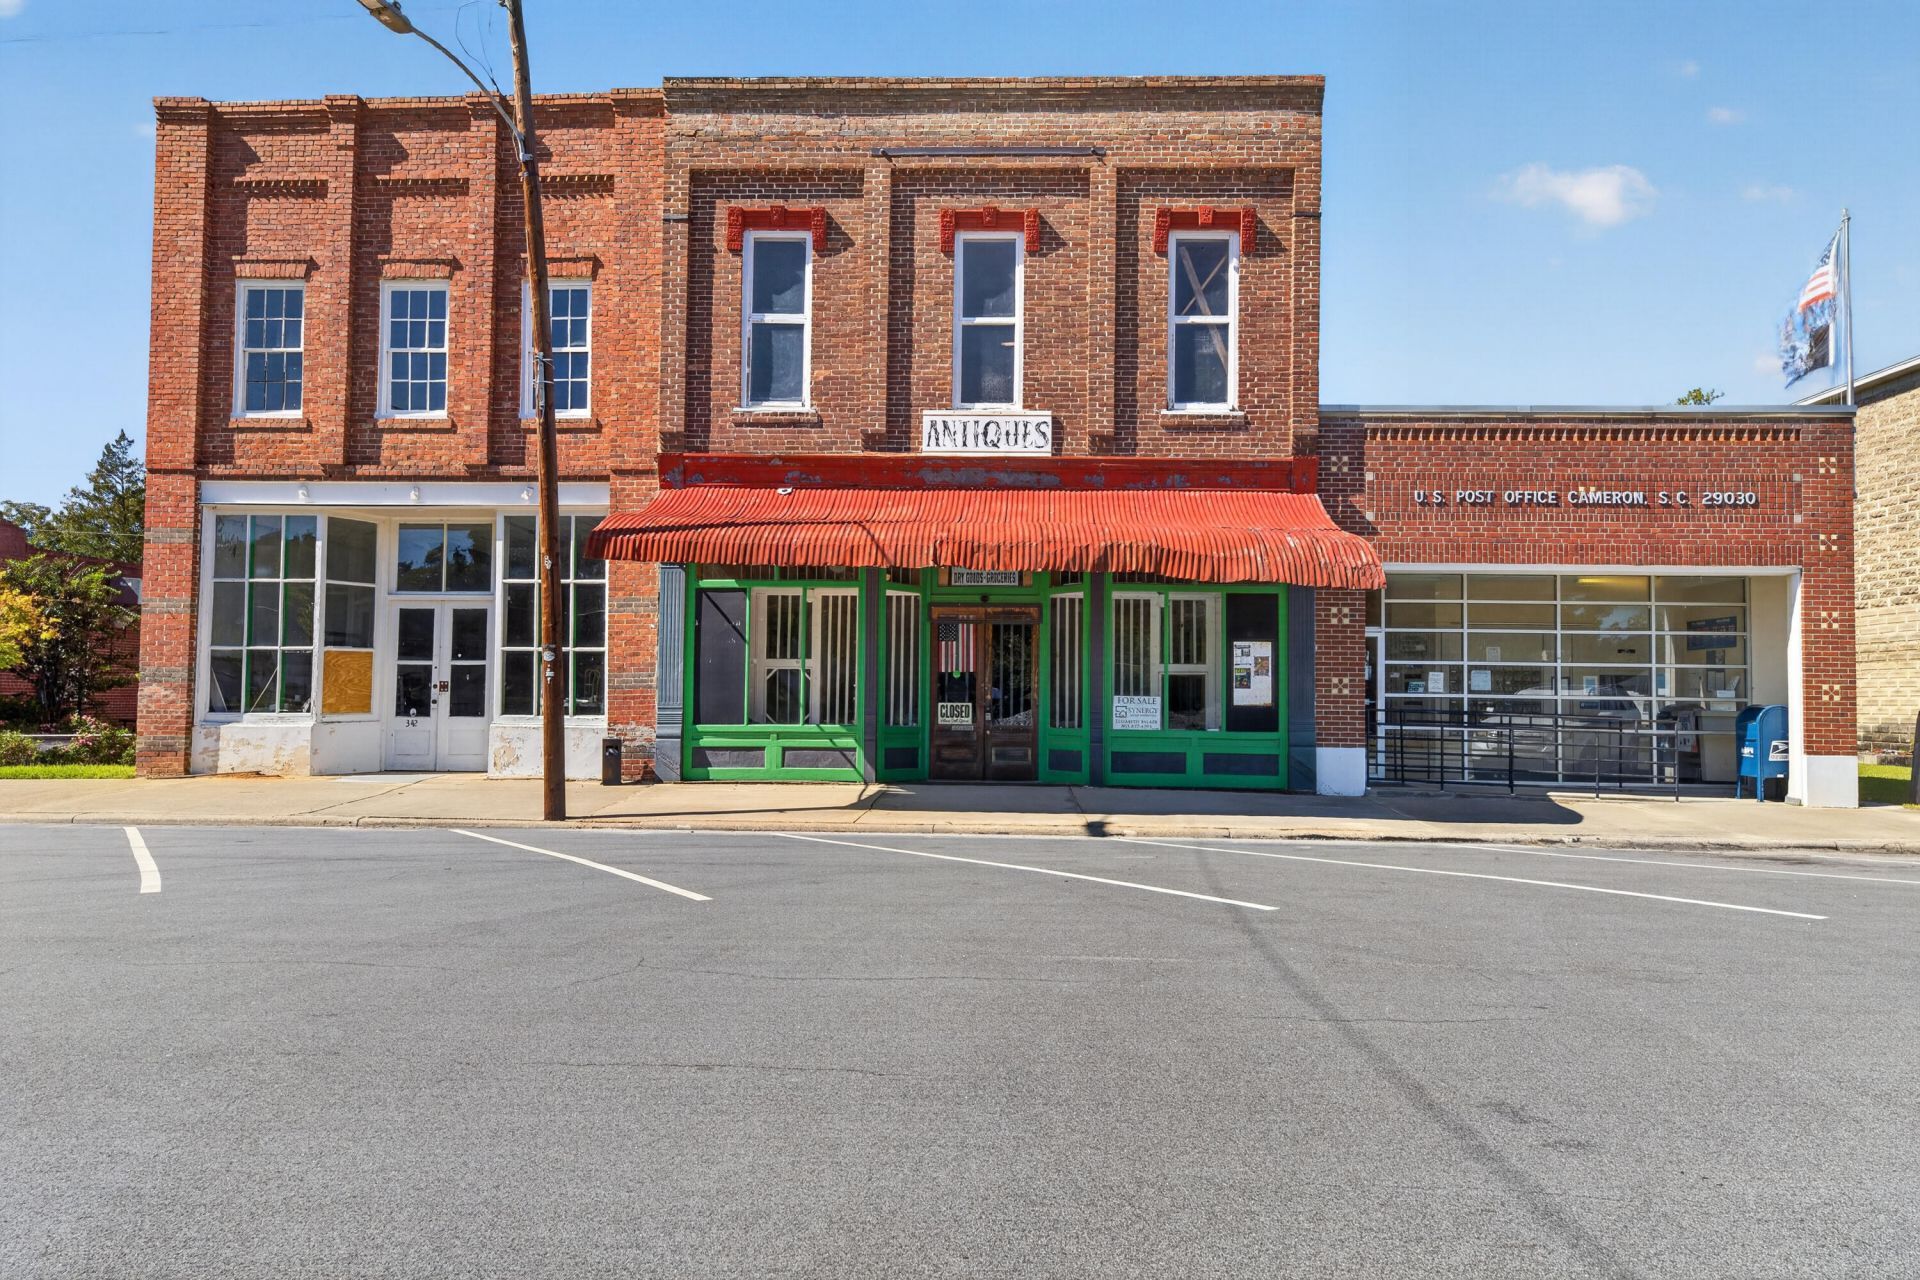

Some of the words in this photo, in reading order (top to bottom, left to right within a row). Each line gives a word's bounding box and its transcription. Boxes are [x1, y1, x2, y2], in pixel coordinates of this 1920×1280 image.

[926, 419, 1050, 449] ANTIQUES
[1456, 490, 1494, 503] POST
[1504, 490, 1557, 504] OFFICE
[1701, 491, 1756, 505] 29030
[953, 572, 965, 584] DRY
[1117, 696, 1135, 705] FOR
[1137, 697, 1157, 705] SALE
[940, 704, 970, 718] CLOSED
[405, 719, 418, 728] 342
